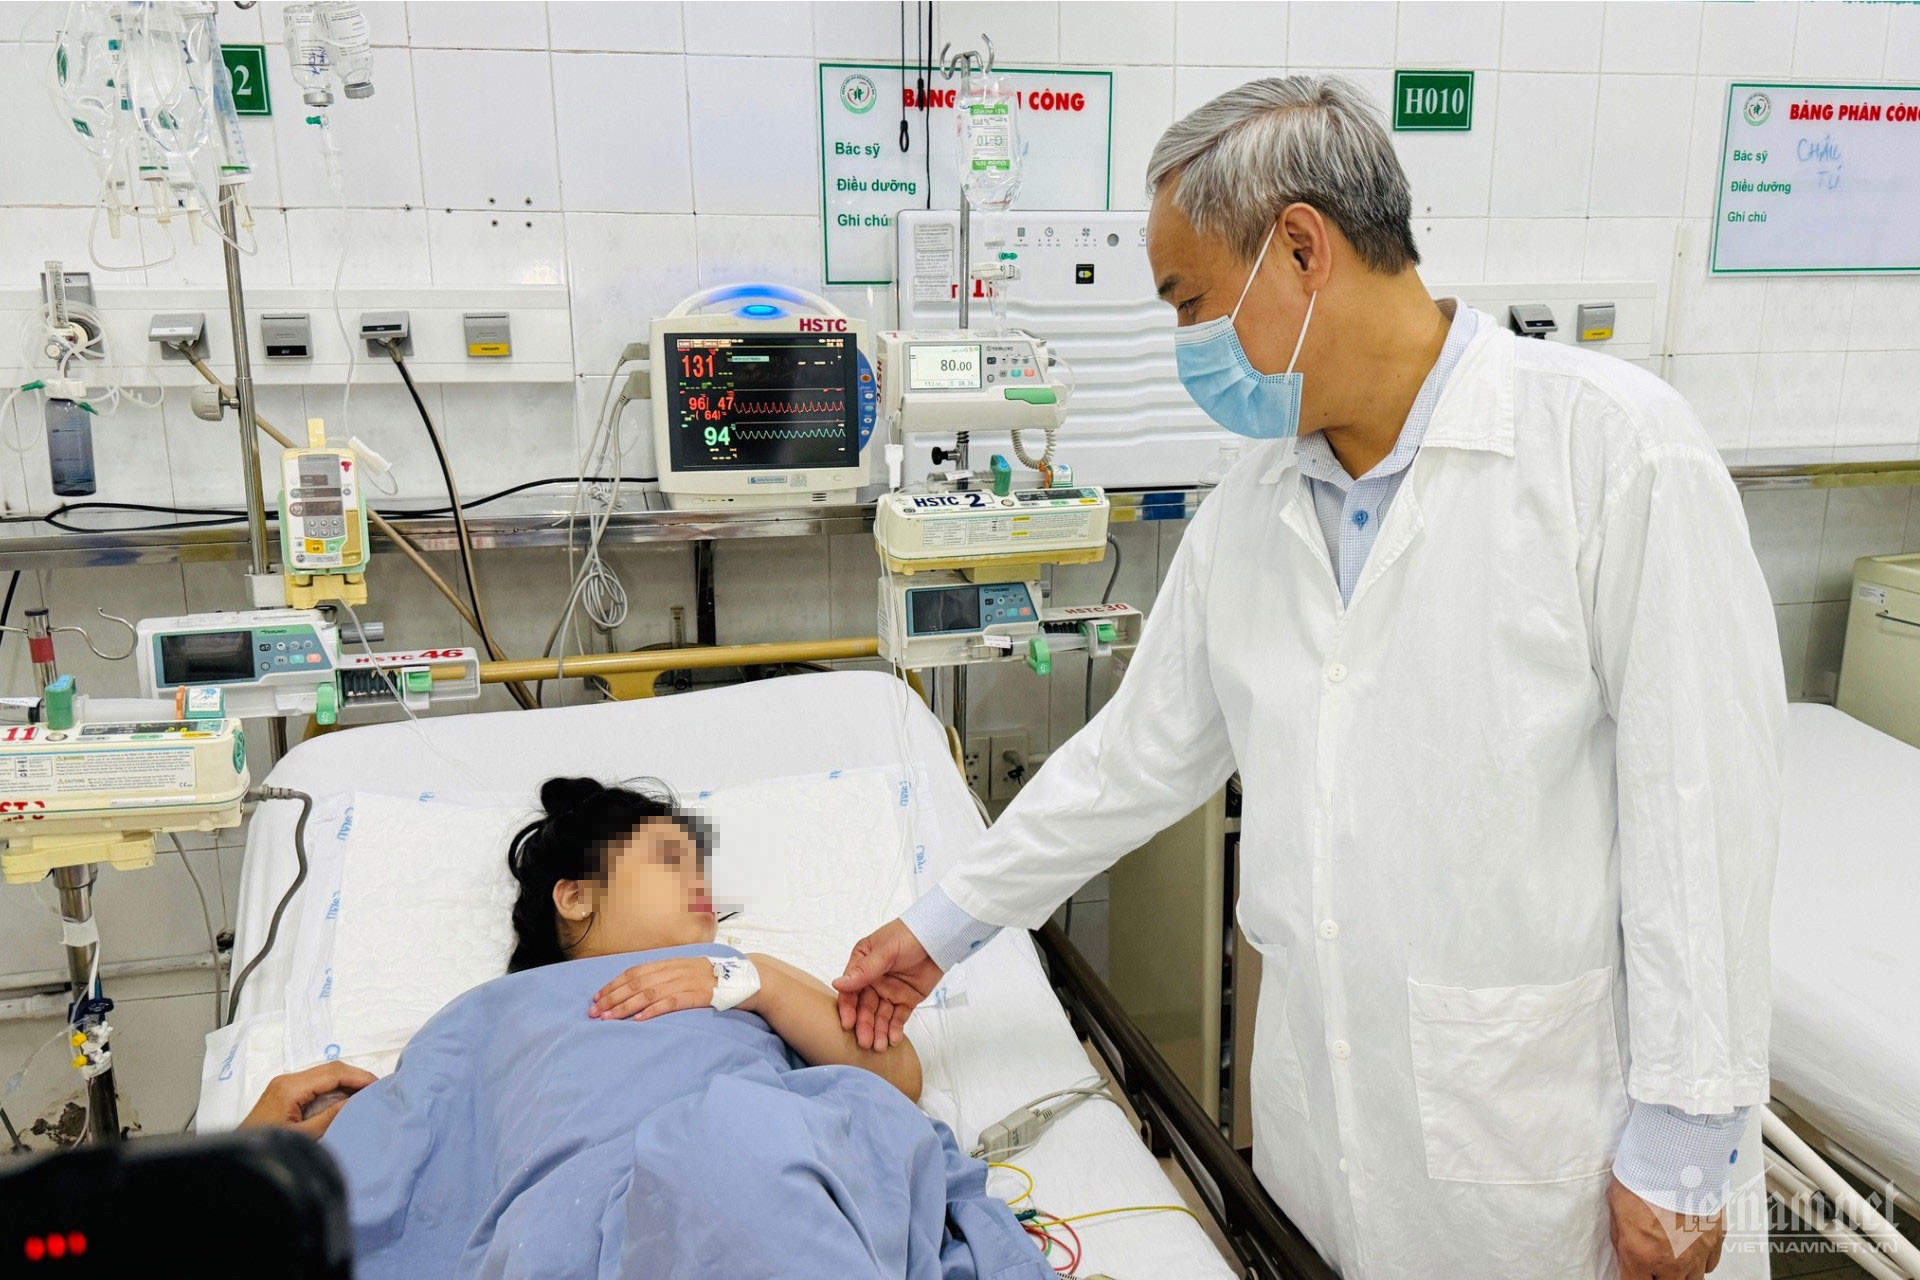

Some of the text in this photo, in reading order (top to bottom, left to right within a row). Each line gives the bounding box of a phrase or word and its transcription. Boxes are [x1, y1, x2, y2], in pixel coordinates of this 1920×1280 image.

[1029, 89, 1085, 111] CÔNG
[1404, 88, 1464, 114] H010
[1790, 99, 1834, 121] BẢNG
[1838, 102, 1881, 121] PHÂN
[1886, 102, 1920, 122] CÔN
[835, 142, 880, 158] Bác sỹ
[1733, 149, 1768, 164] Bác sỹ
[837, 176, 916, 195] Điều dưỡng
[1731, 179, 1791, 194] Điều dưỡng
[837, 213, 889, 227] Ghi chú
[1728, 211, 1766, 222] Ghi chú
[800, 318, 847, 332] HSTC
[682, 355, 713, 377] 131
[940, 359, 972, 371] 80.00
[718, 397, 734, 410] 47
[704, 426, 730, 446] 94
[914, 493, 986, 508] HSTC 2
[356, 650, 463, 663] HSTC 46
[2, 726, 36, 741] 11
